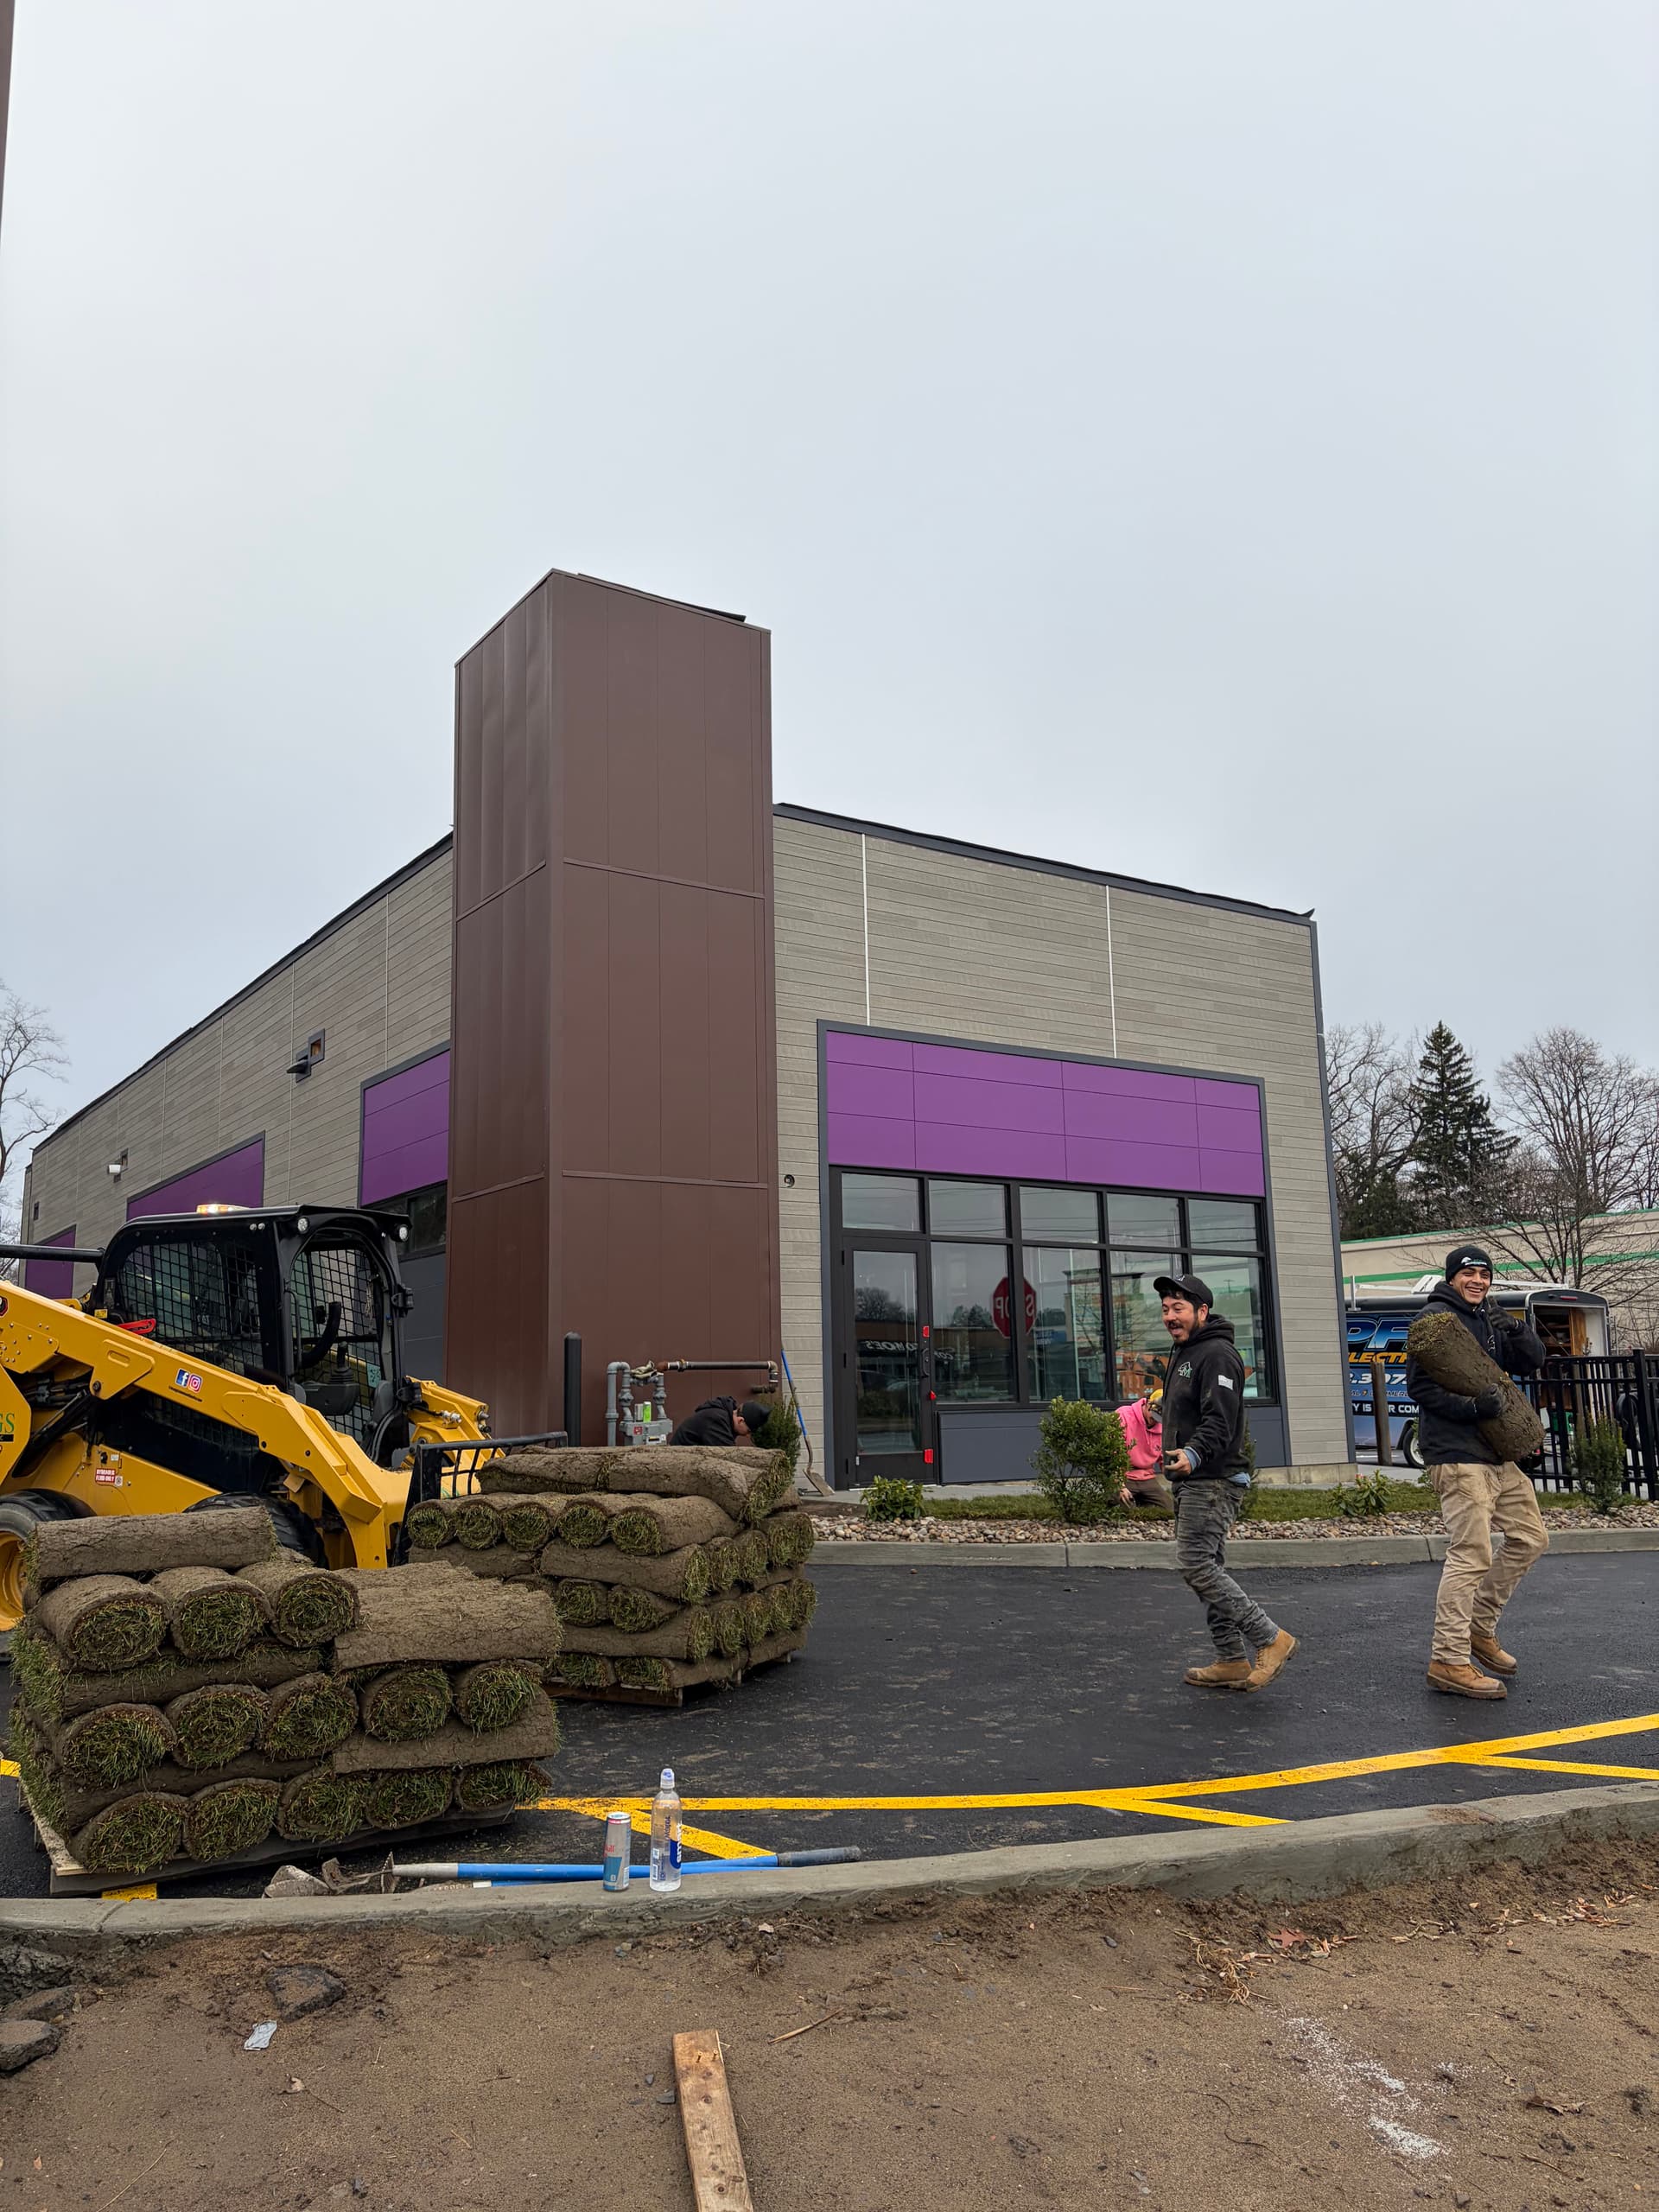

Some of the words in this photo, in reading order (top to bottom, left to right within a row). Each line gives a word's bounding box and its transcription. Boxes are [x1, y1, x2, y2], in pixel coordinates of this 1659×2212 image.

[1348, 1352, 1408, 1363] LECT
[1362, 1403, 1372, 1412] IS
[0, 1412, 16, 1434] S
